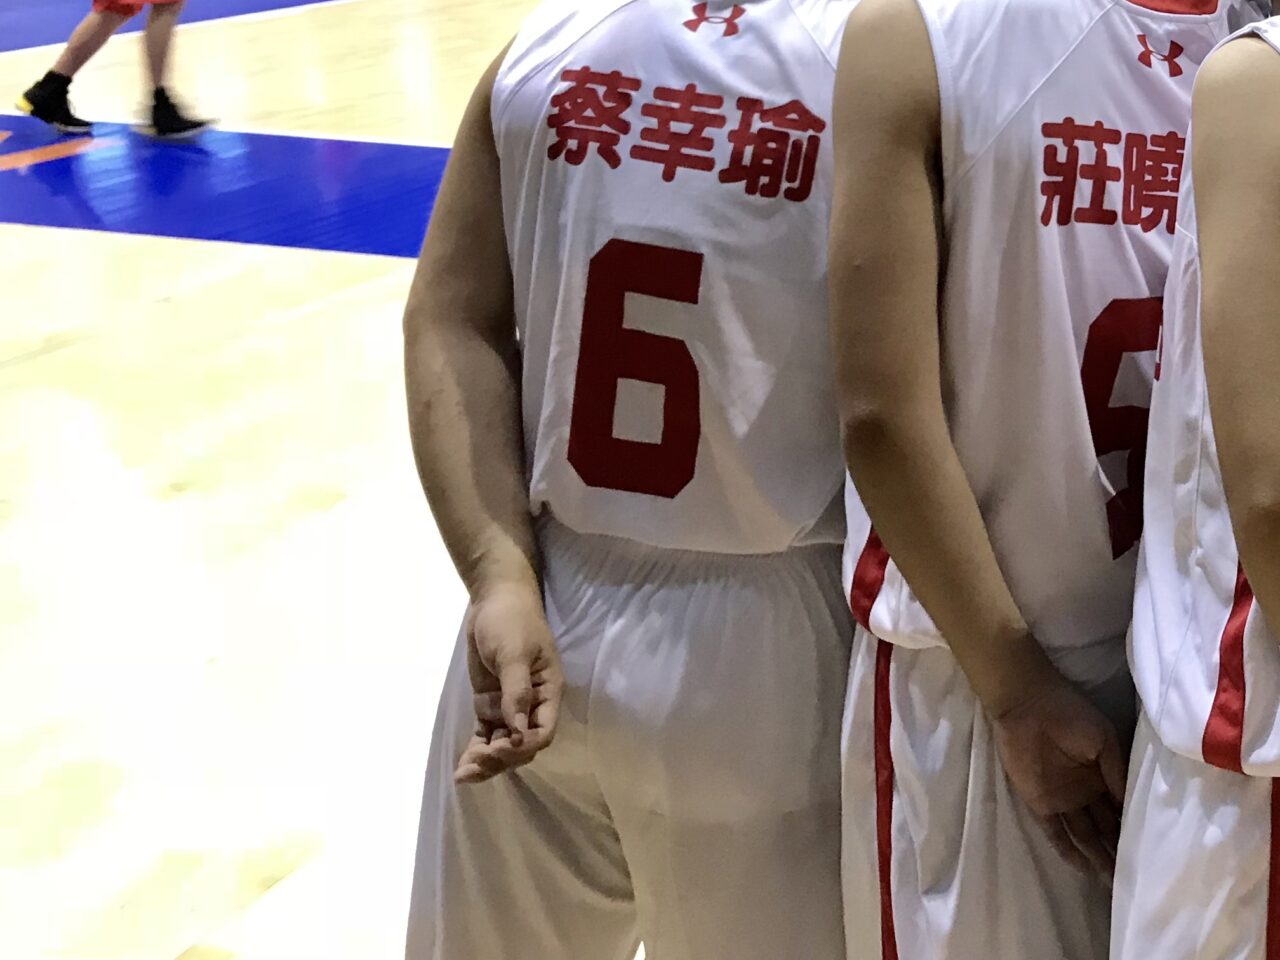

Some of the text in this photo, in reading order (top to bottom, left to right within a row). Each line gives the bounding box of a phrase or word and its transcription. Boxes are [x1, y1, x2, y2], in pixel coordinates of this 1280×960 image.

[547, 66, 827, 203] 蔡幸瑜
[567, 238, 705, 499] 6
